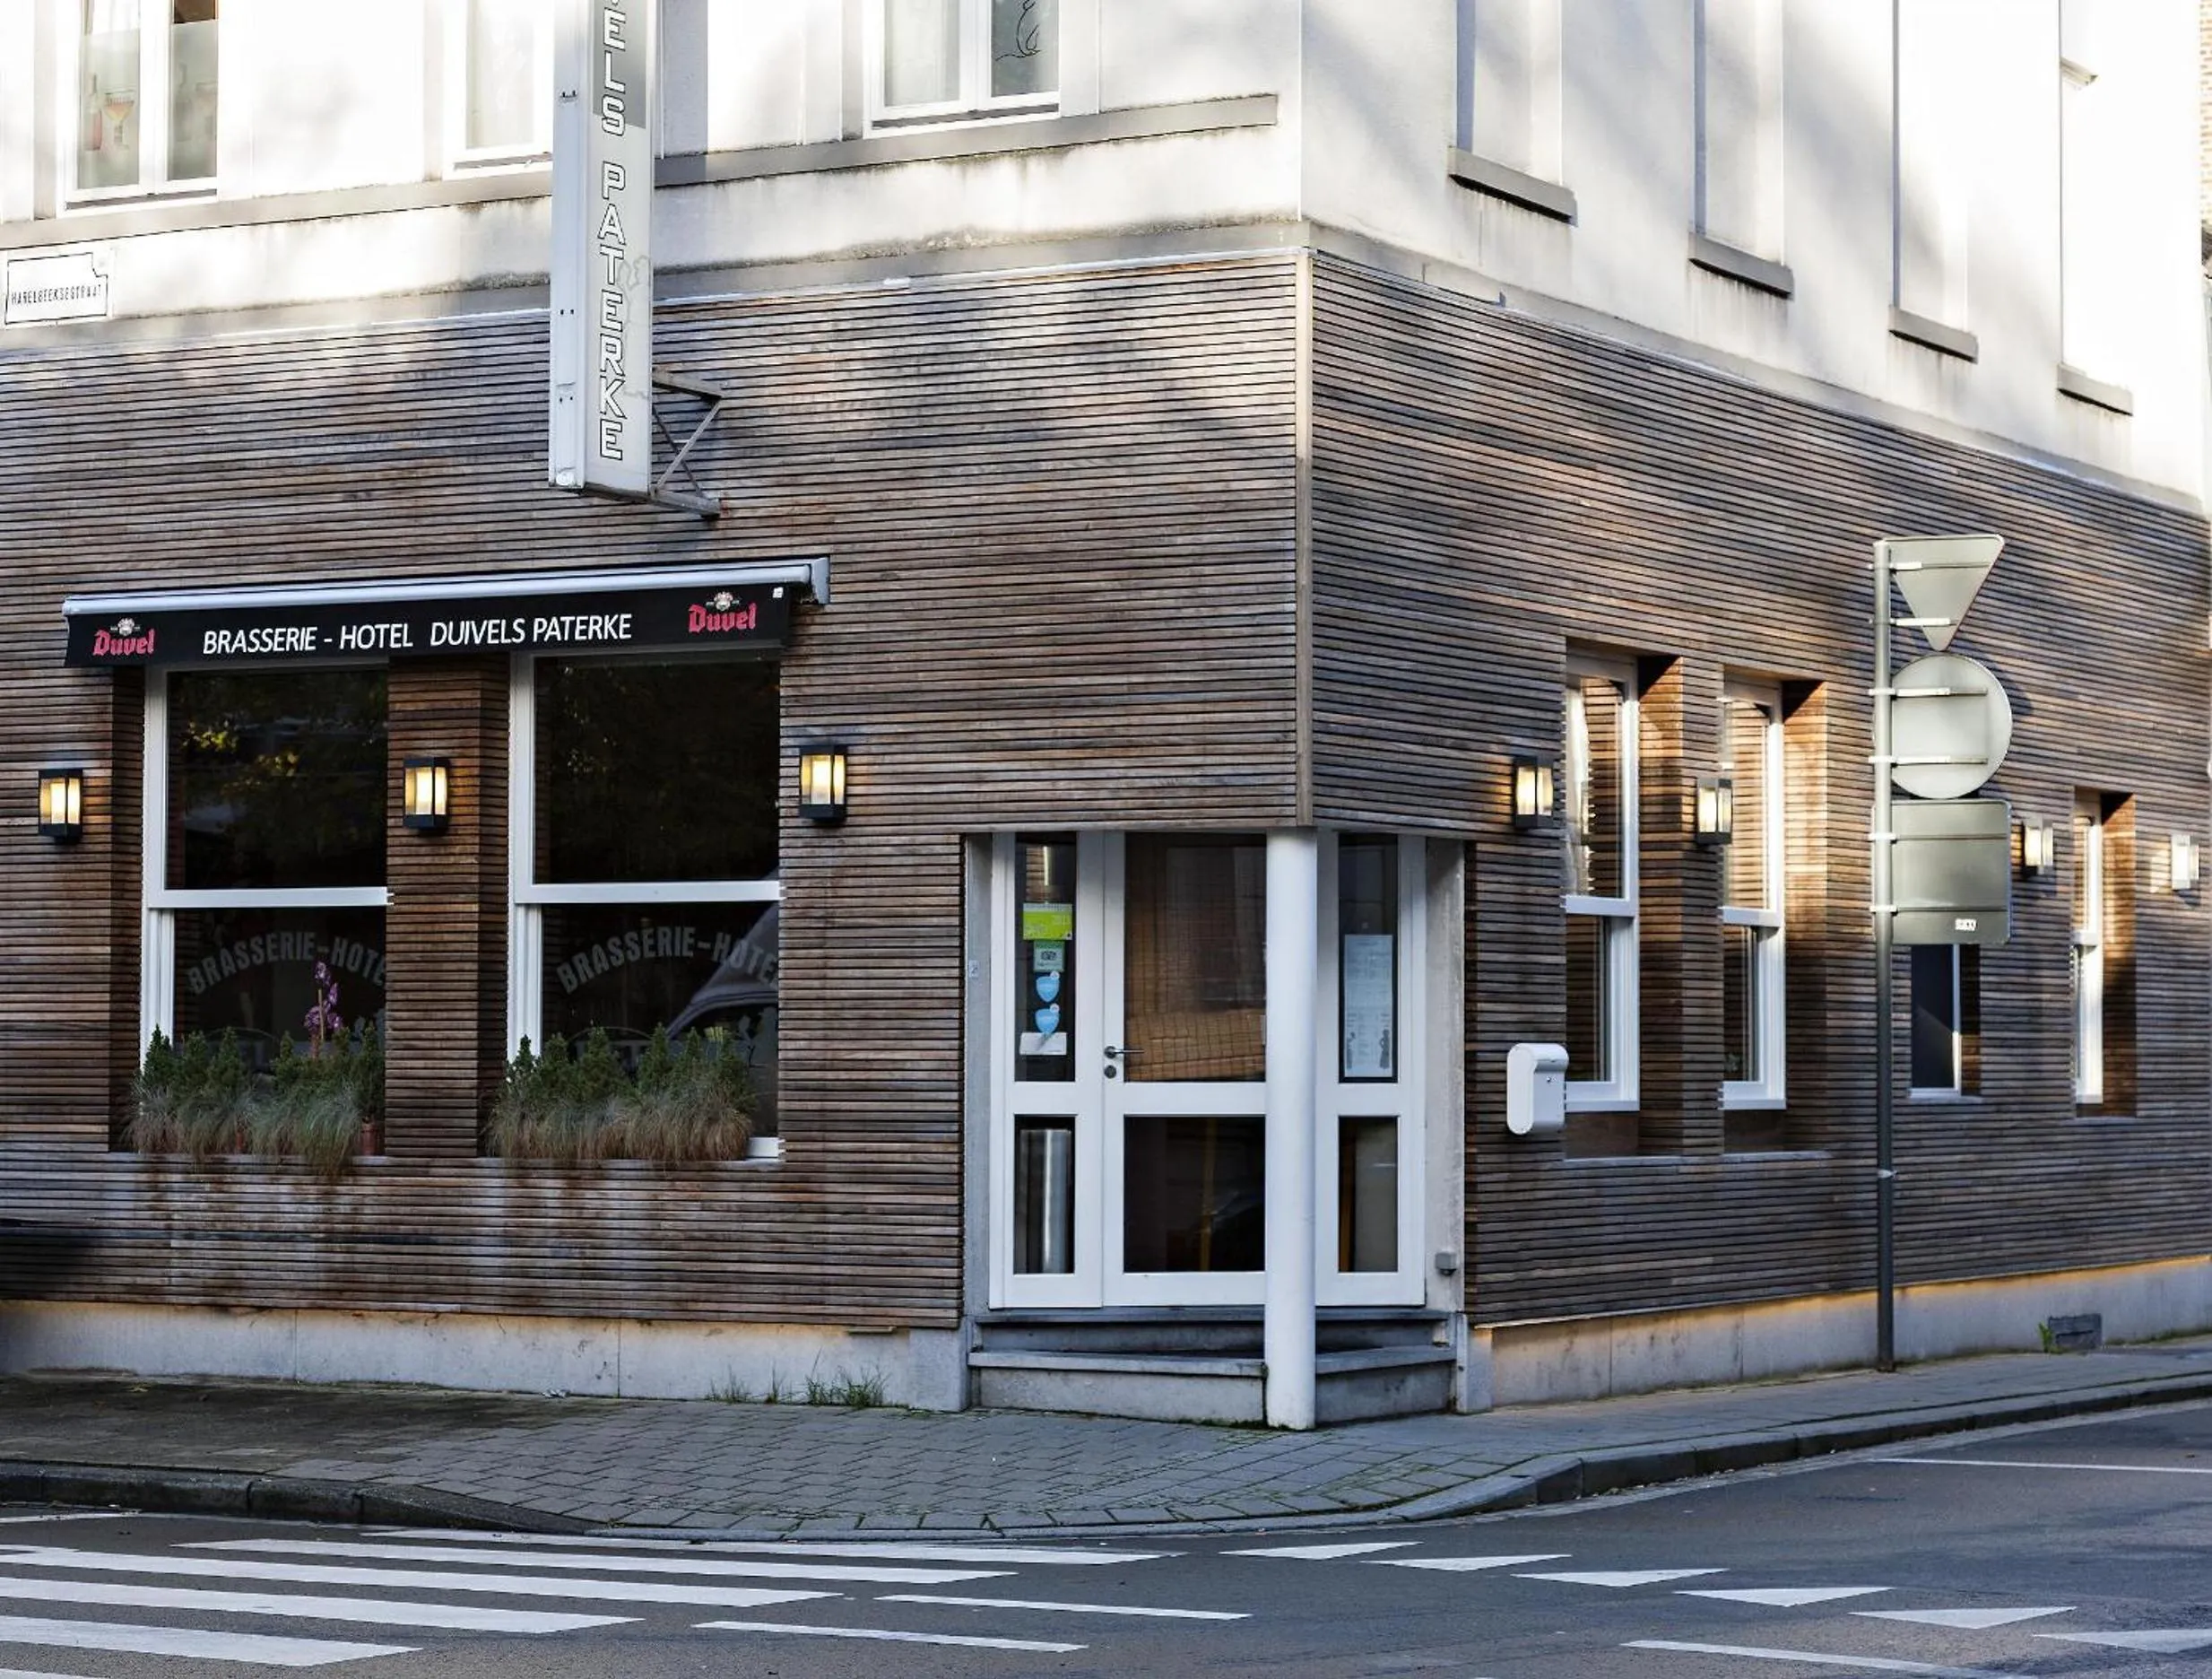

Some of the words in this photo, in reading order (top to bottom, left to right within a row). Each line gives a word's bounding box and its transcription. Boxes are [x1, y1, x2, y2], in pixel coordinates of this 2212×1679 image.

[601, 0, 626, 136] ELS
[598, 161, 628, 461] PATERKE
[203, 627, 318, 655] BRASSERIE
[340, 622, 413, 649] HOTEL
[430, 617, 525, 646] DUIVELS
[533, 613, 632, 642] PATERKE
[688, 603, 757, 633] Duvel
[92, 629, 155, 657] Duvel
